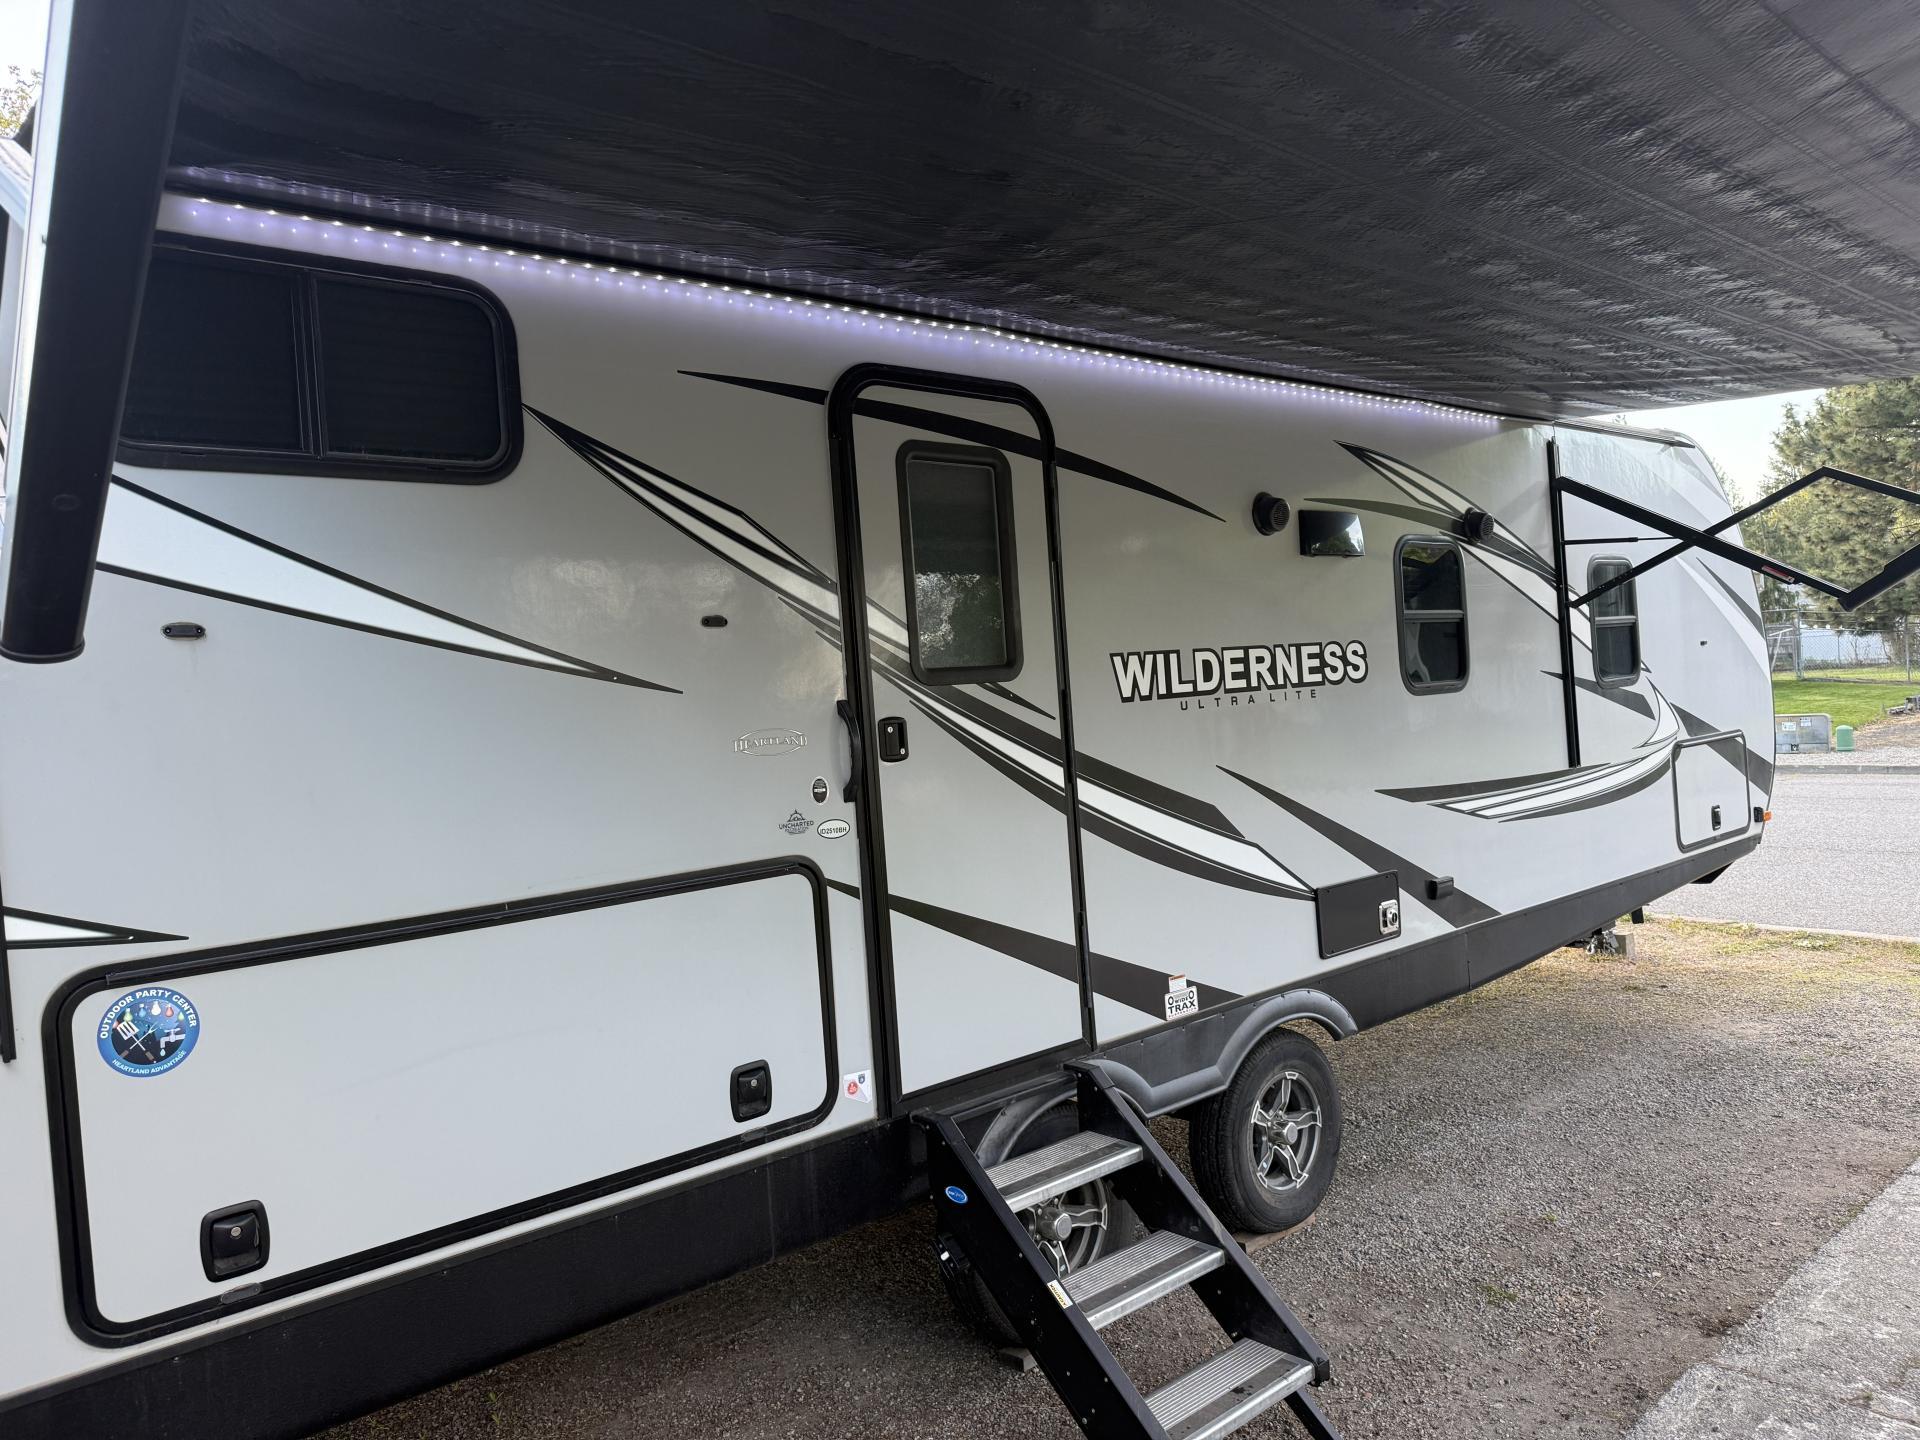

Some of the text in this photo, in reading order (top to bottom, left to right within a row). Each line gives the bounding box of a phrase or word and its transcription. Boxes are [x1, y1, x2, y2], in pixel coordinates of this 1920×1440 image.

[1110, 640, 1368, 703] WILDERNESS
[734, 735, 808, 752] HEARTLAND
[778, 820, 814, 830] UNCHARTED
[100, 989, 197, 1039] OUTDOOR PARTY CENTER
[1168, 999, 1196, 1014] TRAX
[112, 1050, 187, 1074] HEARTLAND ADVANTAGE
